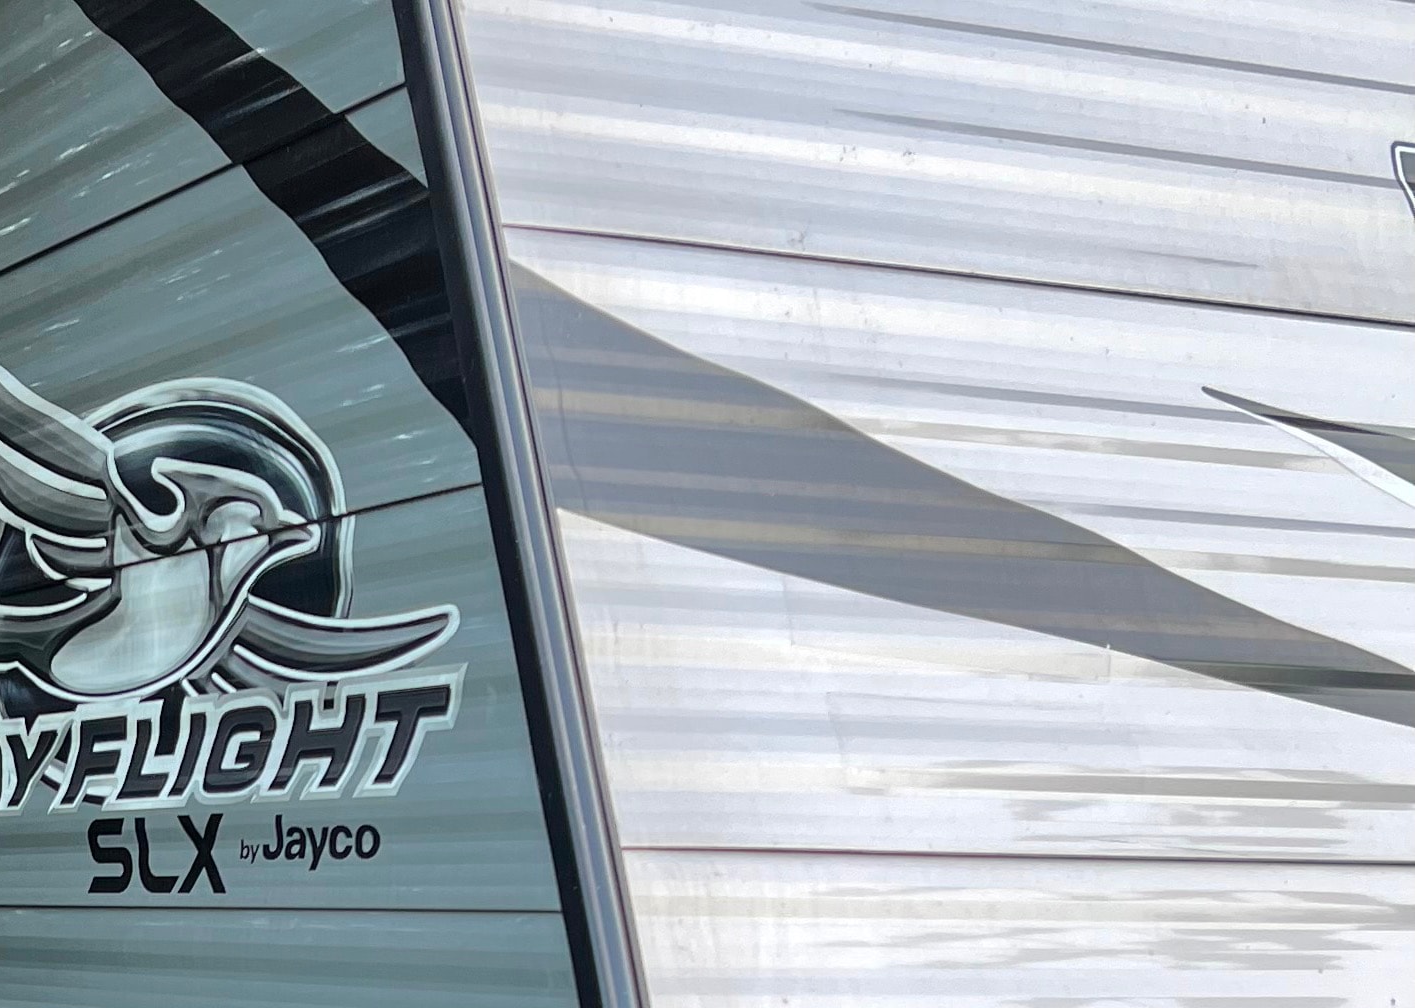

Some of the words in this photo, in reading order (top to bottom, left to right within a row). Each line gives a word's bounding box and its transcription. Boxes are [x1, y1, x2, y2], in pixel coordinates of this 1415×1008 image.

[57, 678, 456, 808] FLIGHT
[88, 813, 226, 894] SLX
[239, 839, 260, 864] by
[263, 814, 381, 871] Jayco
